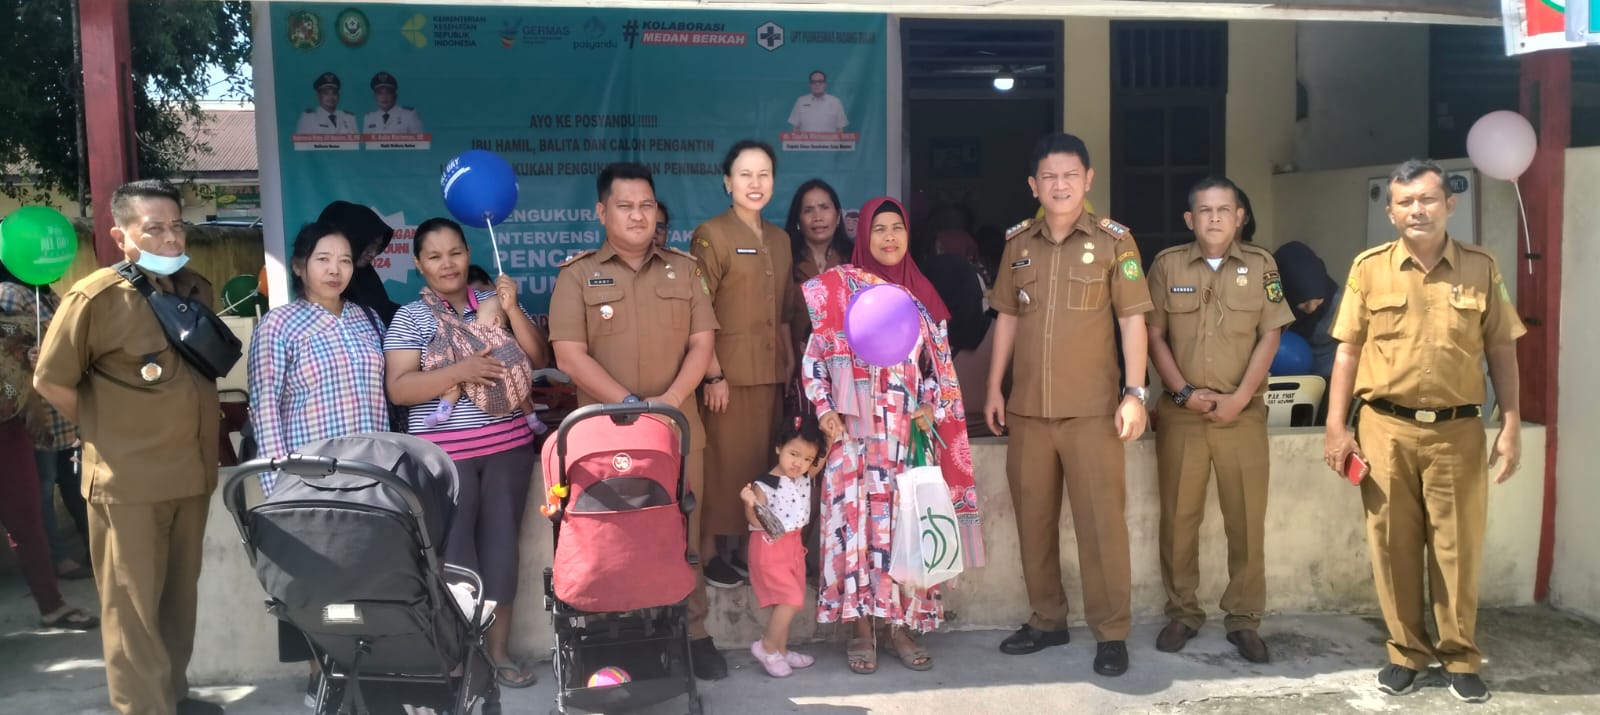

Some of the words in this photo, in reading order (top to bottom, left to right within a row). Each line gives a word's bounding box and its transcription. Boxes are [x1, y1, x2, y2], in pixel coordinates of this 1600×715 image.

[643, 32, 689, 43] MEDAN
[692, 34, 746, 45] BERKAH
[529, 114, 552, 128] AYO
[556, 114, 572, 128] KE
[575, 114, 636, 128] POSYANDU
[495, 138, 537, 154] HAMIL,
[539, 138, 580, 152] BALITA
[583, 138, 607, 152] DAN
[609, 138, 646, 152] CALON
[649, 138, 715, 153] PENGANTIN
